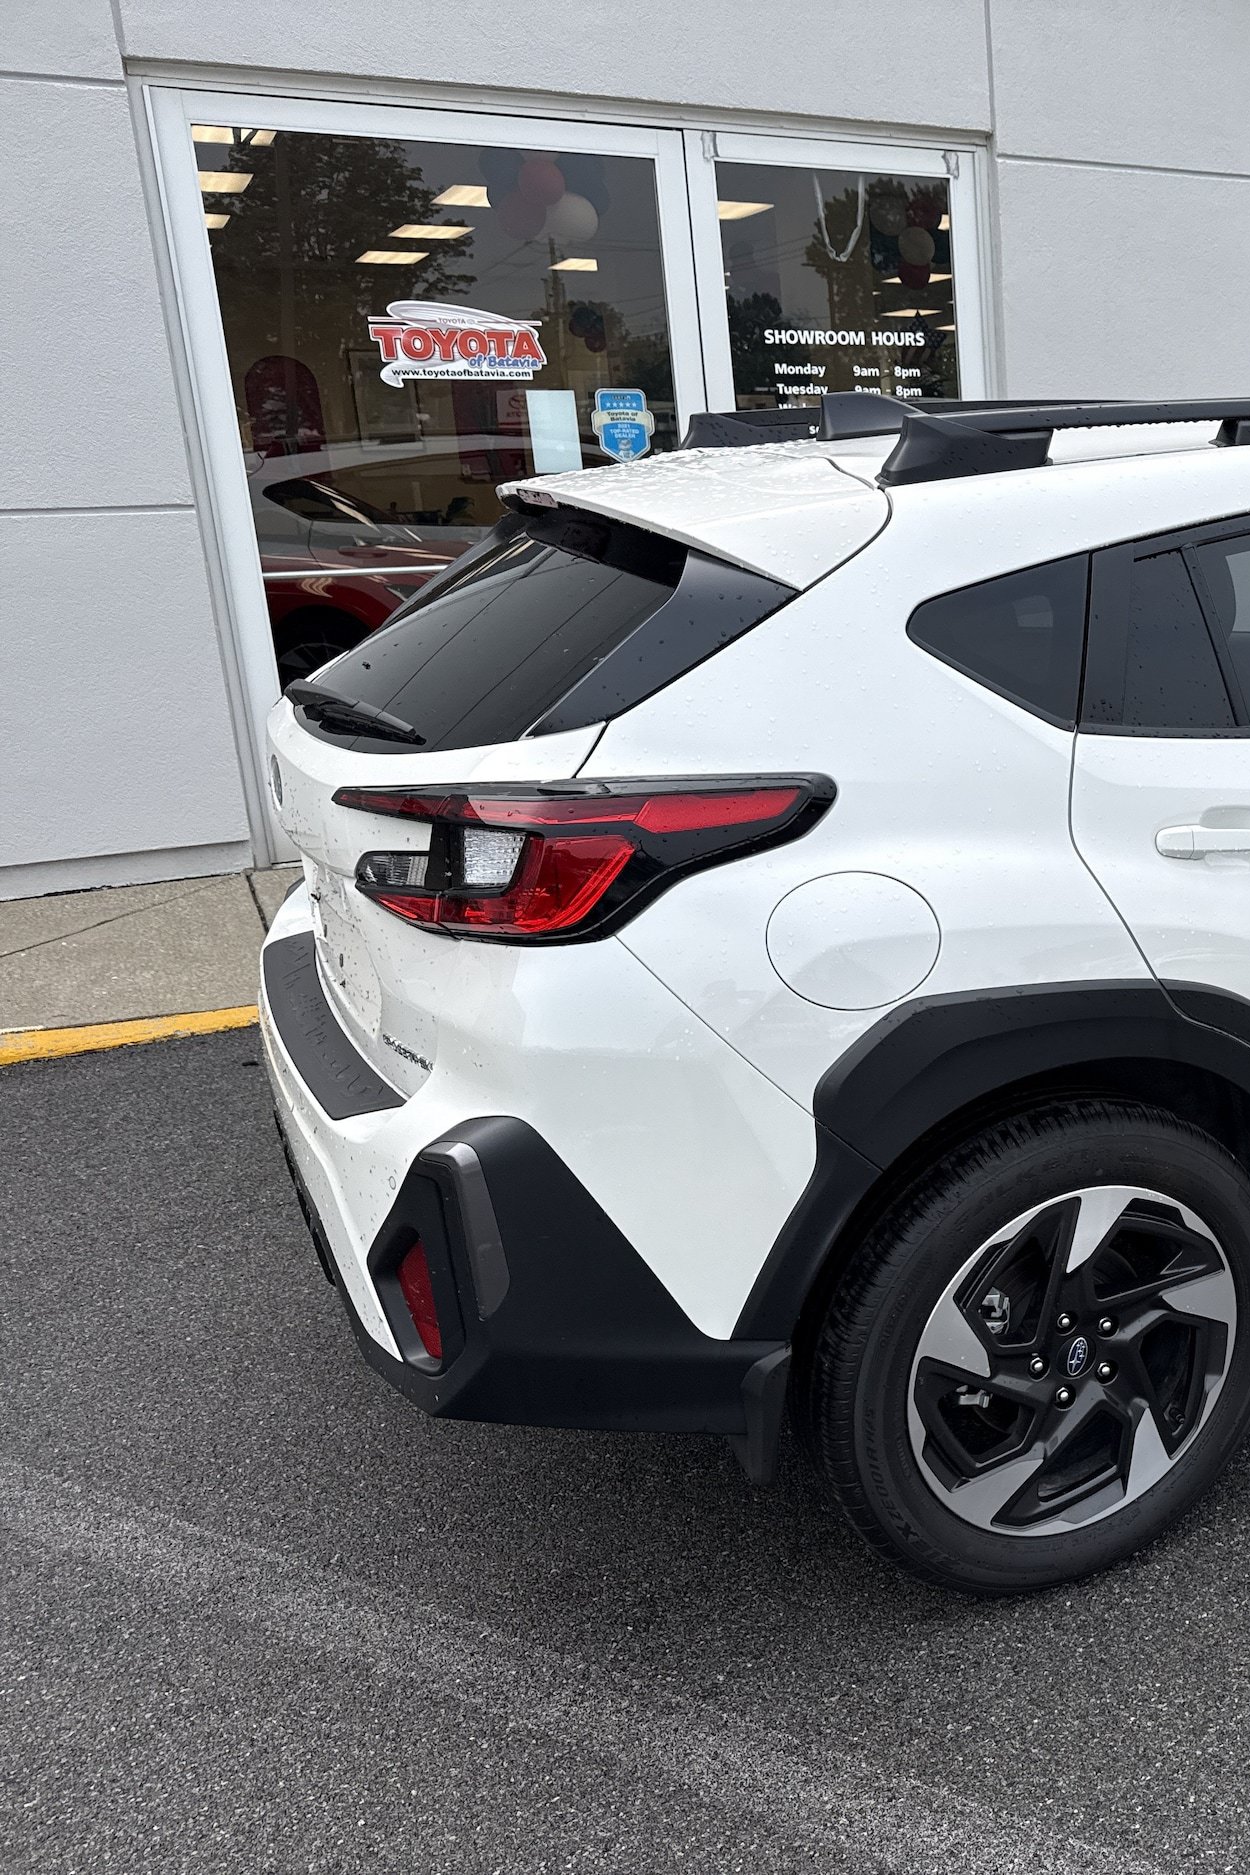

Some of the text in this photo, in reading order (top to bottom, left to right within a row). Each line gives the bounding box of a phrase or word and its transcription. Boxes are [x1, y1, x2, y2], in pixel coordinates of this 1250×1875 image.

[438, 317, 466, 325] TOYOTA
[371, 328, 543, 361] TOYOTA
[764, 329, 925, 347] SHOWROOM HOURS
[469, 355, 539, 368] of Batavia
[392, 369, 531, 378] www.toyotaofbatavia.com
[774, 363, 826, 377] Monday
[853, 365, 880, 377] 9am
[894, 366, 921, 379] 8pm
[776, 383, 828, 395] Tuesday
[895, 385, 922, 399] 8pm
